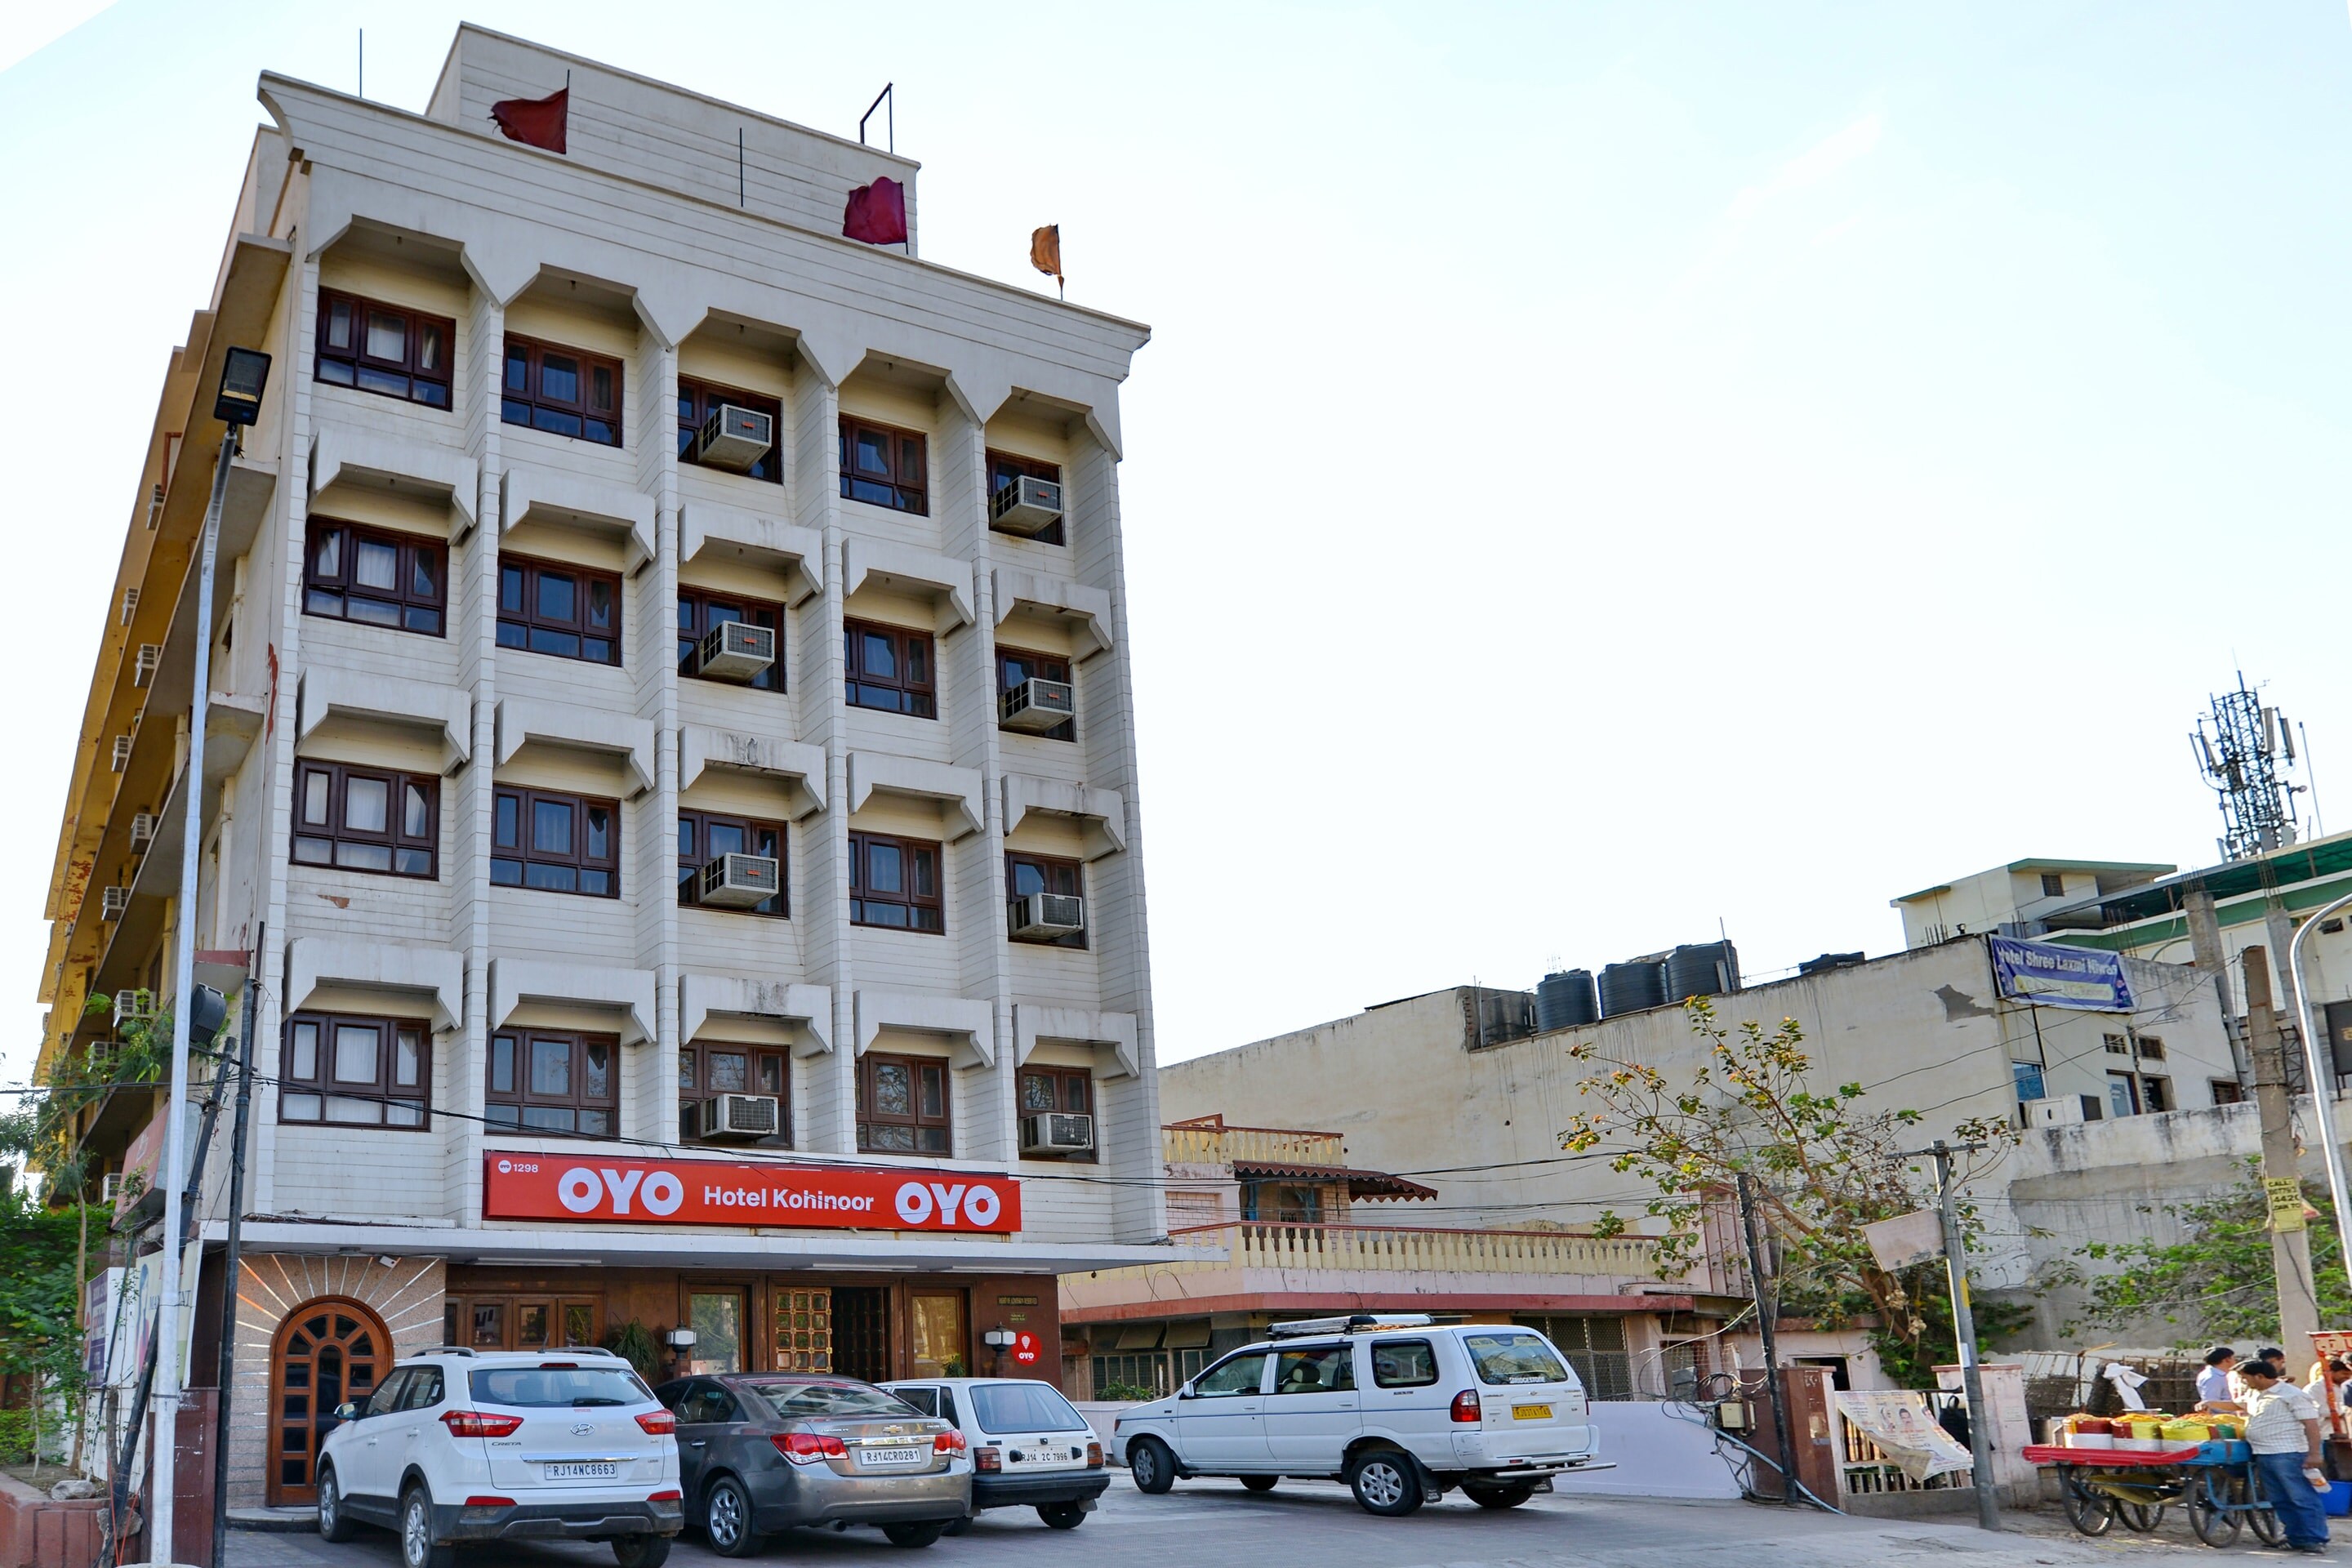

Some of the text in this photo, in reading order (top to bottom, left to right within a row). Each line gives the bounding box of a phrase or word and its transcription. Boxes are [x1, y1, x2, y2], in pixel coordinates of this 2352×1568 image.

[2025, 951, 2055, 969] Shree
[2056, 954, 2085, 973] Laxmi
[513, 1163, 539, 1173] 1298
[558, 1167, 684, 1217] OYO
[704, 1185, 875, 1212] Hotel Kohinoor
[895, 1182, 1000, 1226] OYO
[1042, 1453, 1051, 1461] 2C
[1053, 1452, 1068, 1462] 7996
[553, 1463, 616, 1477] RJ14NC8663
